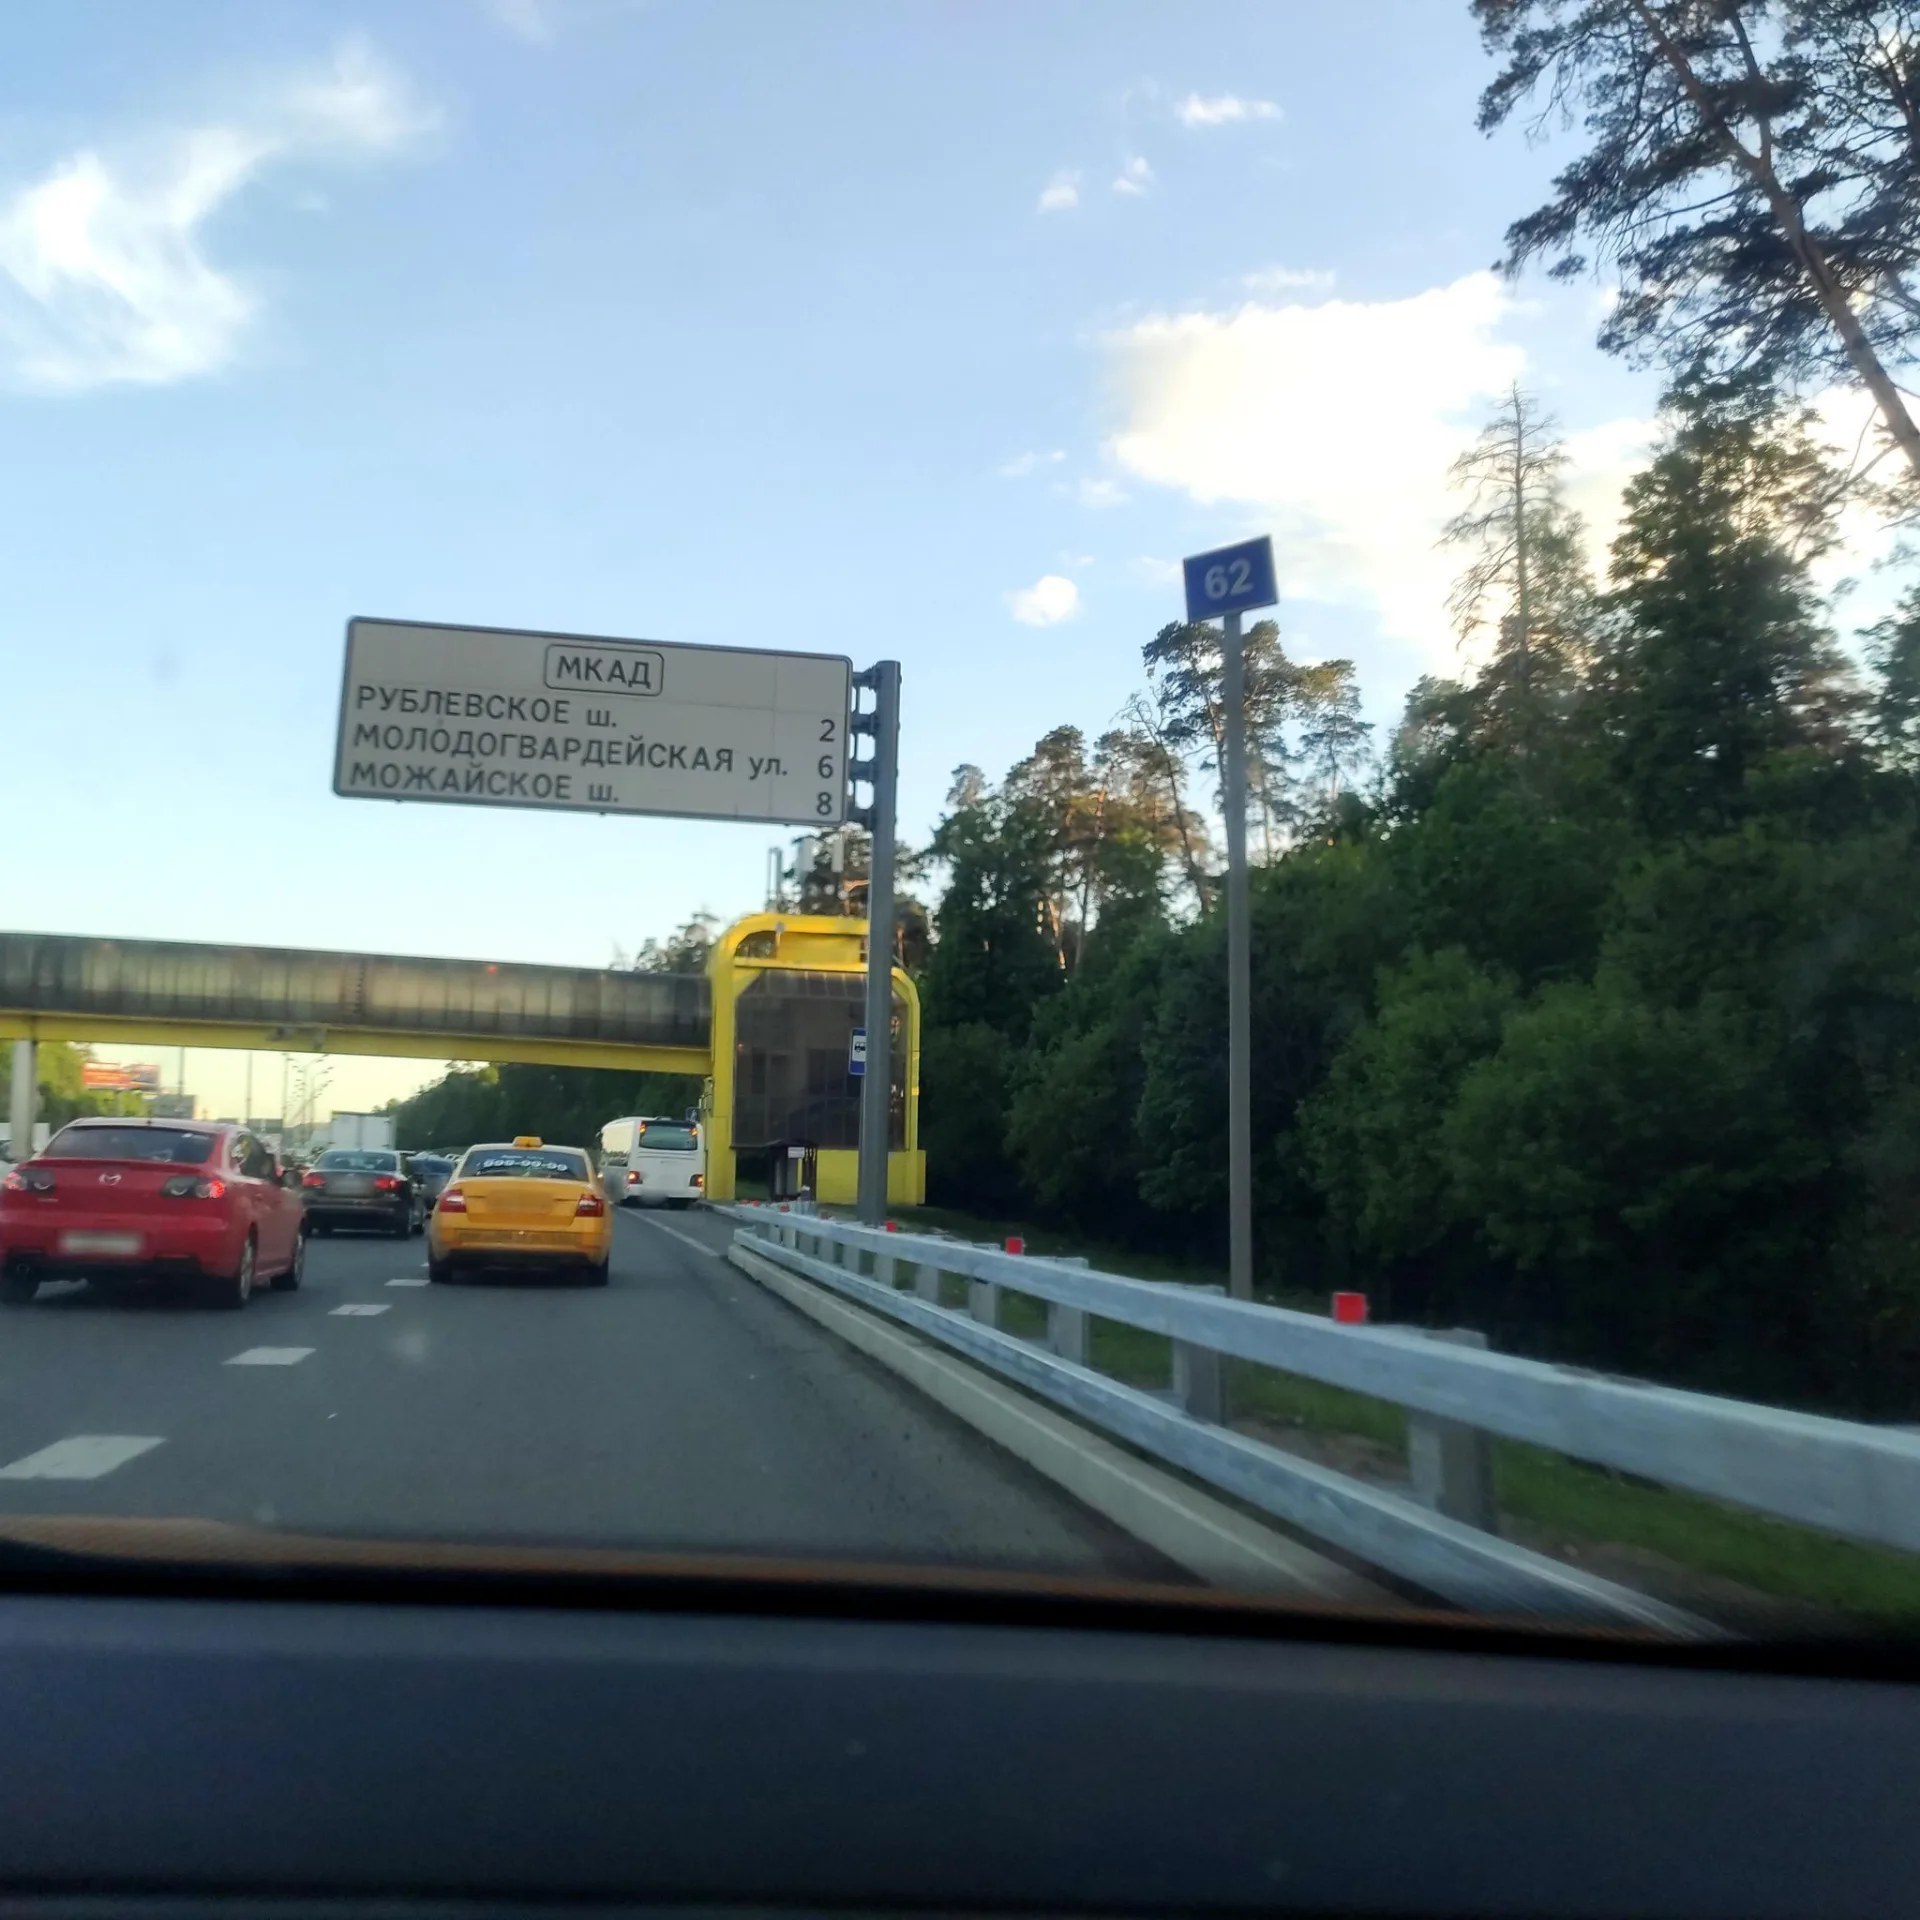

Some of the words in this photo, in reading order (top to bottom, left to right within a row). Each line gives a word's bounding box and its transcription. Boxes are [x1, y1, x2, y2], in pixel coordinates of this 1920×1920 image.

[1204, 557, 1254, 600] 62
[557, 656, 651, 688] МКАД
[356, 685, 570, 724] РУБЛЕВСКОЕ
[587, 709, 618, 728] ш.
[820, 719, 836, 742] 2
[353, 722, 734, 772] МОЛОДОГВАРДЕЙСКАЯ
[749, 757, 788, 780] ул.
[818, 755, 834, 779] 6
[350, 761, 572, 800] МОЖАЙСКОЕ
[588, 785, 620, 803] ш.
[816, 792, 833, 816] 8
